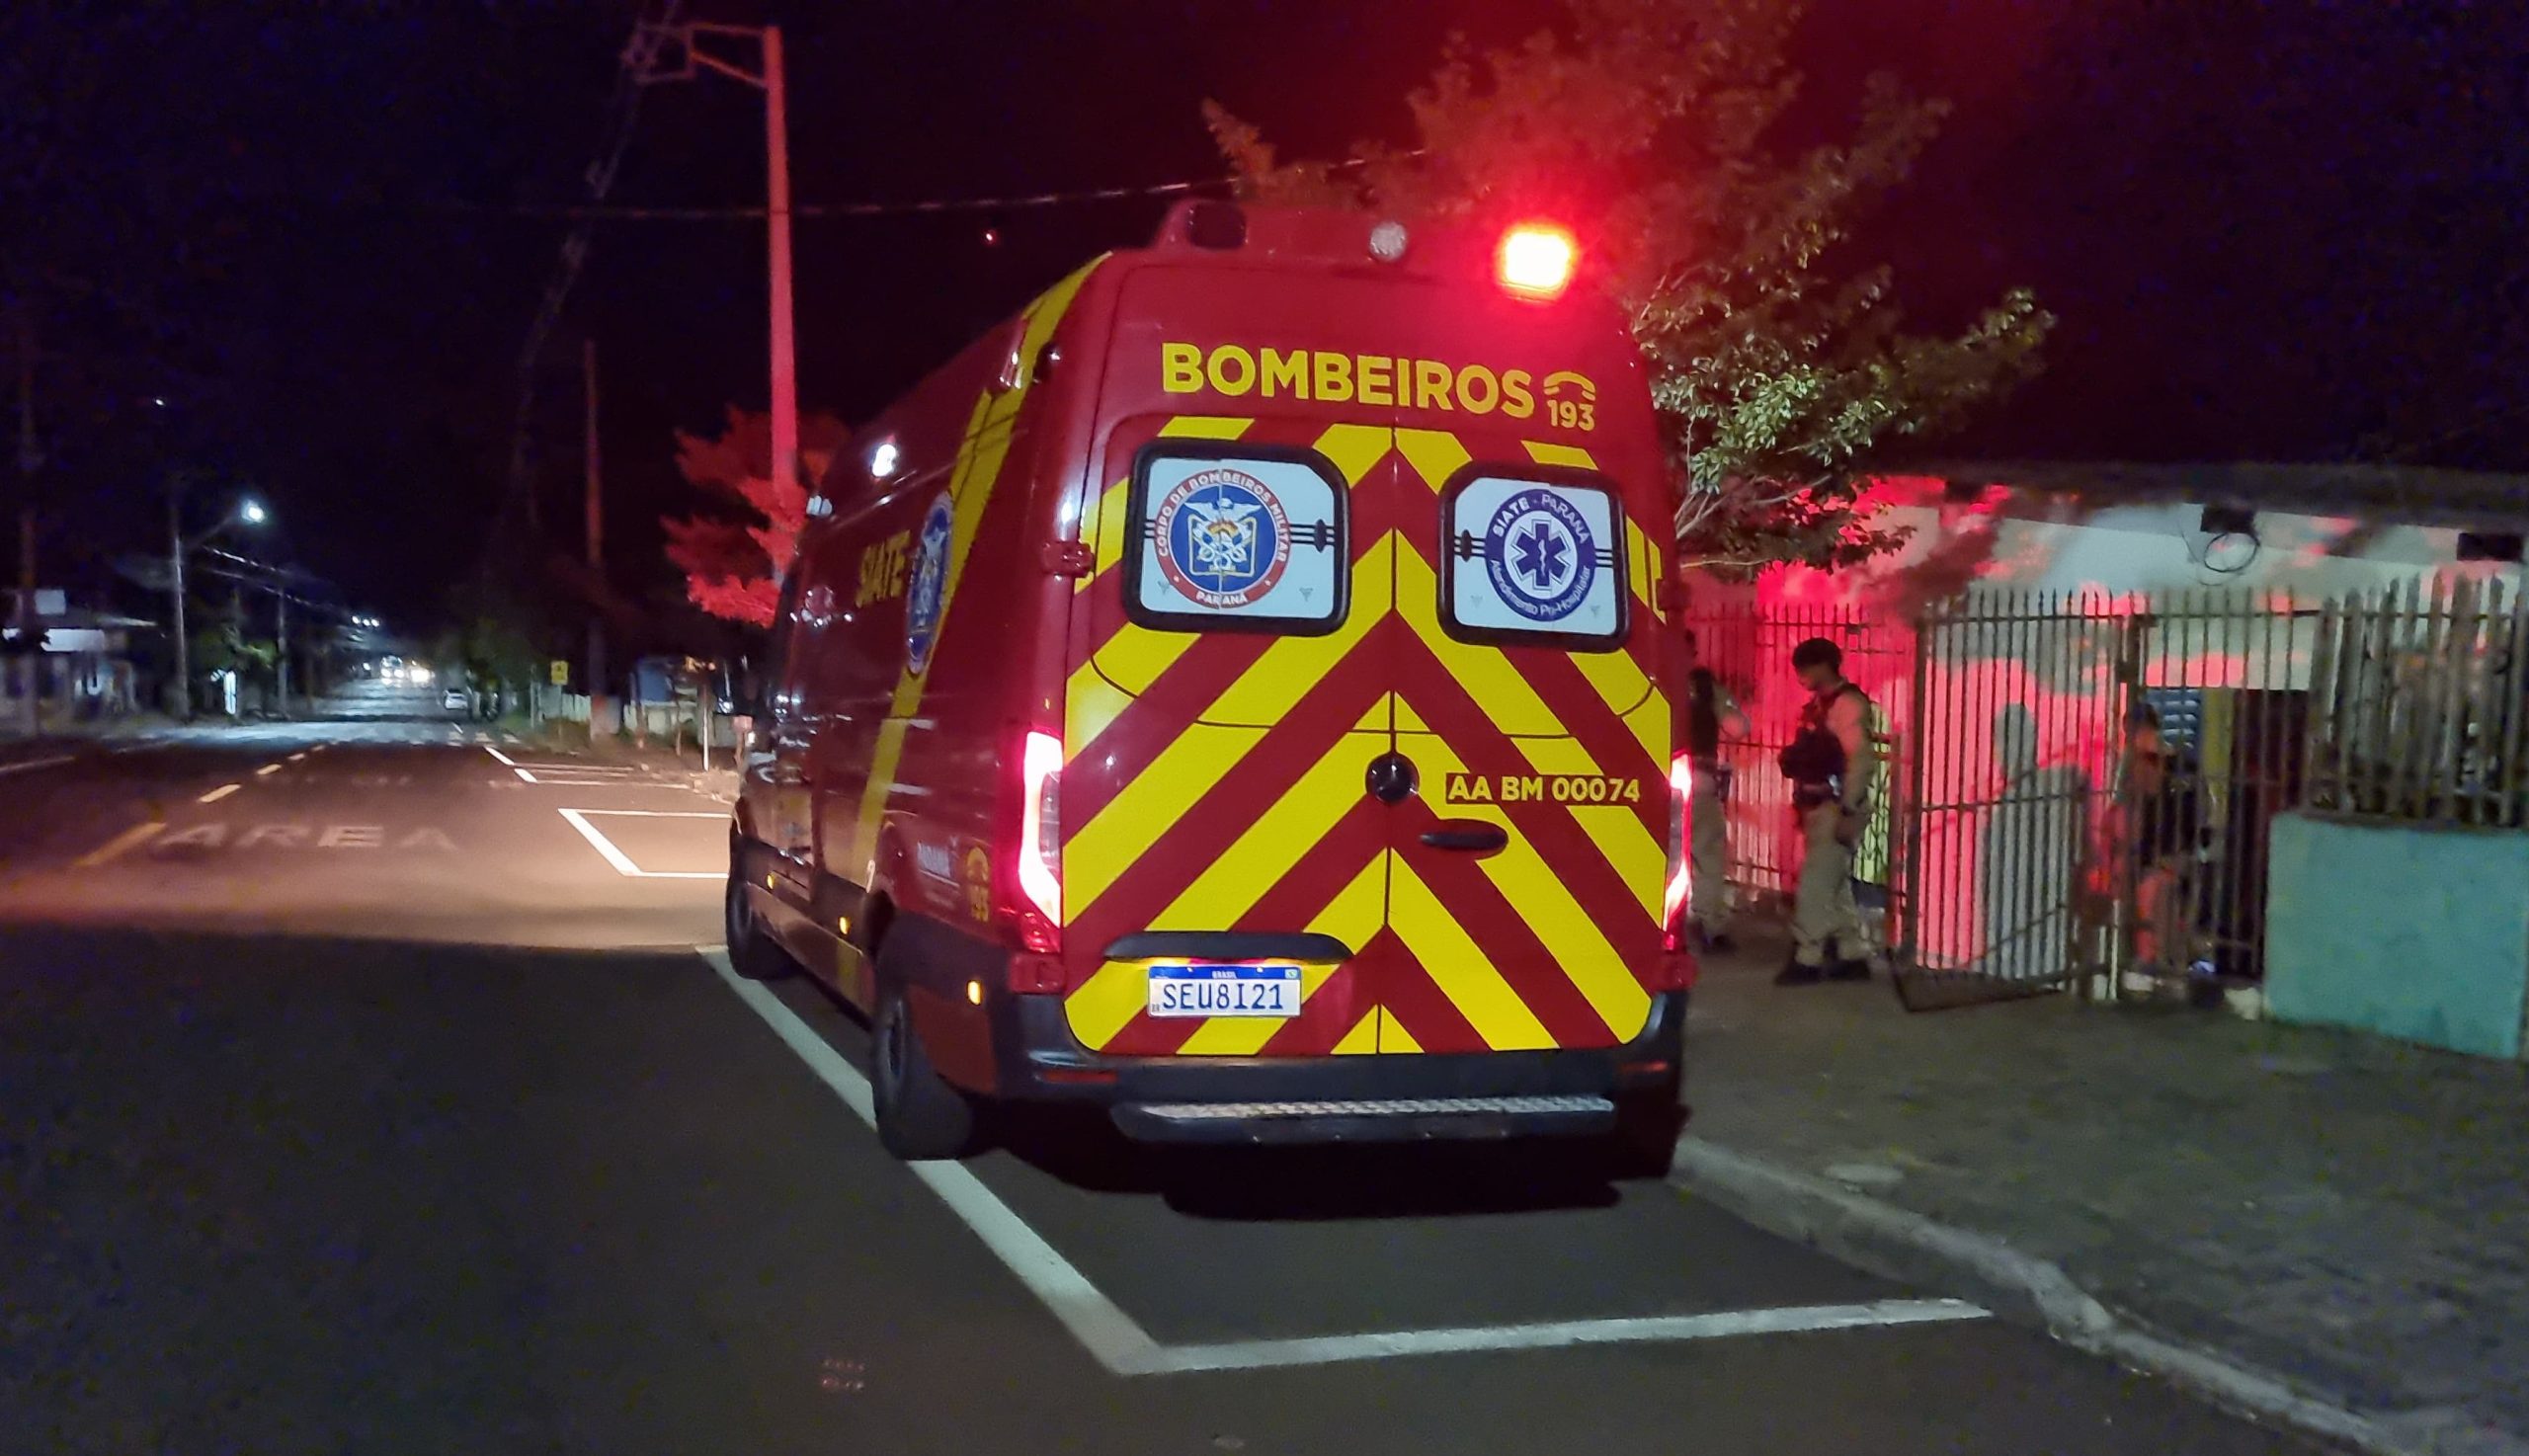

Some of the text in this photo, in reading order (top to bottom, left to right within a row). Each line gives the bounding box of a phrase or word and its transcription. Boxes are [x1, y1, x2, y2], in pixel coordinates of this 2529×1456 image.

[1162, 343, 1534, 418] BOMBEIROS
[1547, 399, 1594, 431] 193
[1157, 472, 1289, 561] CORPO DE BOMBEIROS MILITAR
[1493, 497, 1530, 537] SIATE
[856, 529, 911, 608] SIATE
[1448, 775, 1641, 802] AA BM 00074
[1163, 983, 1283, 1010] SEU8I21
